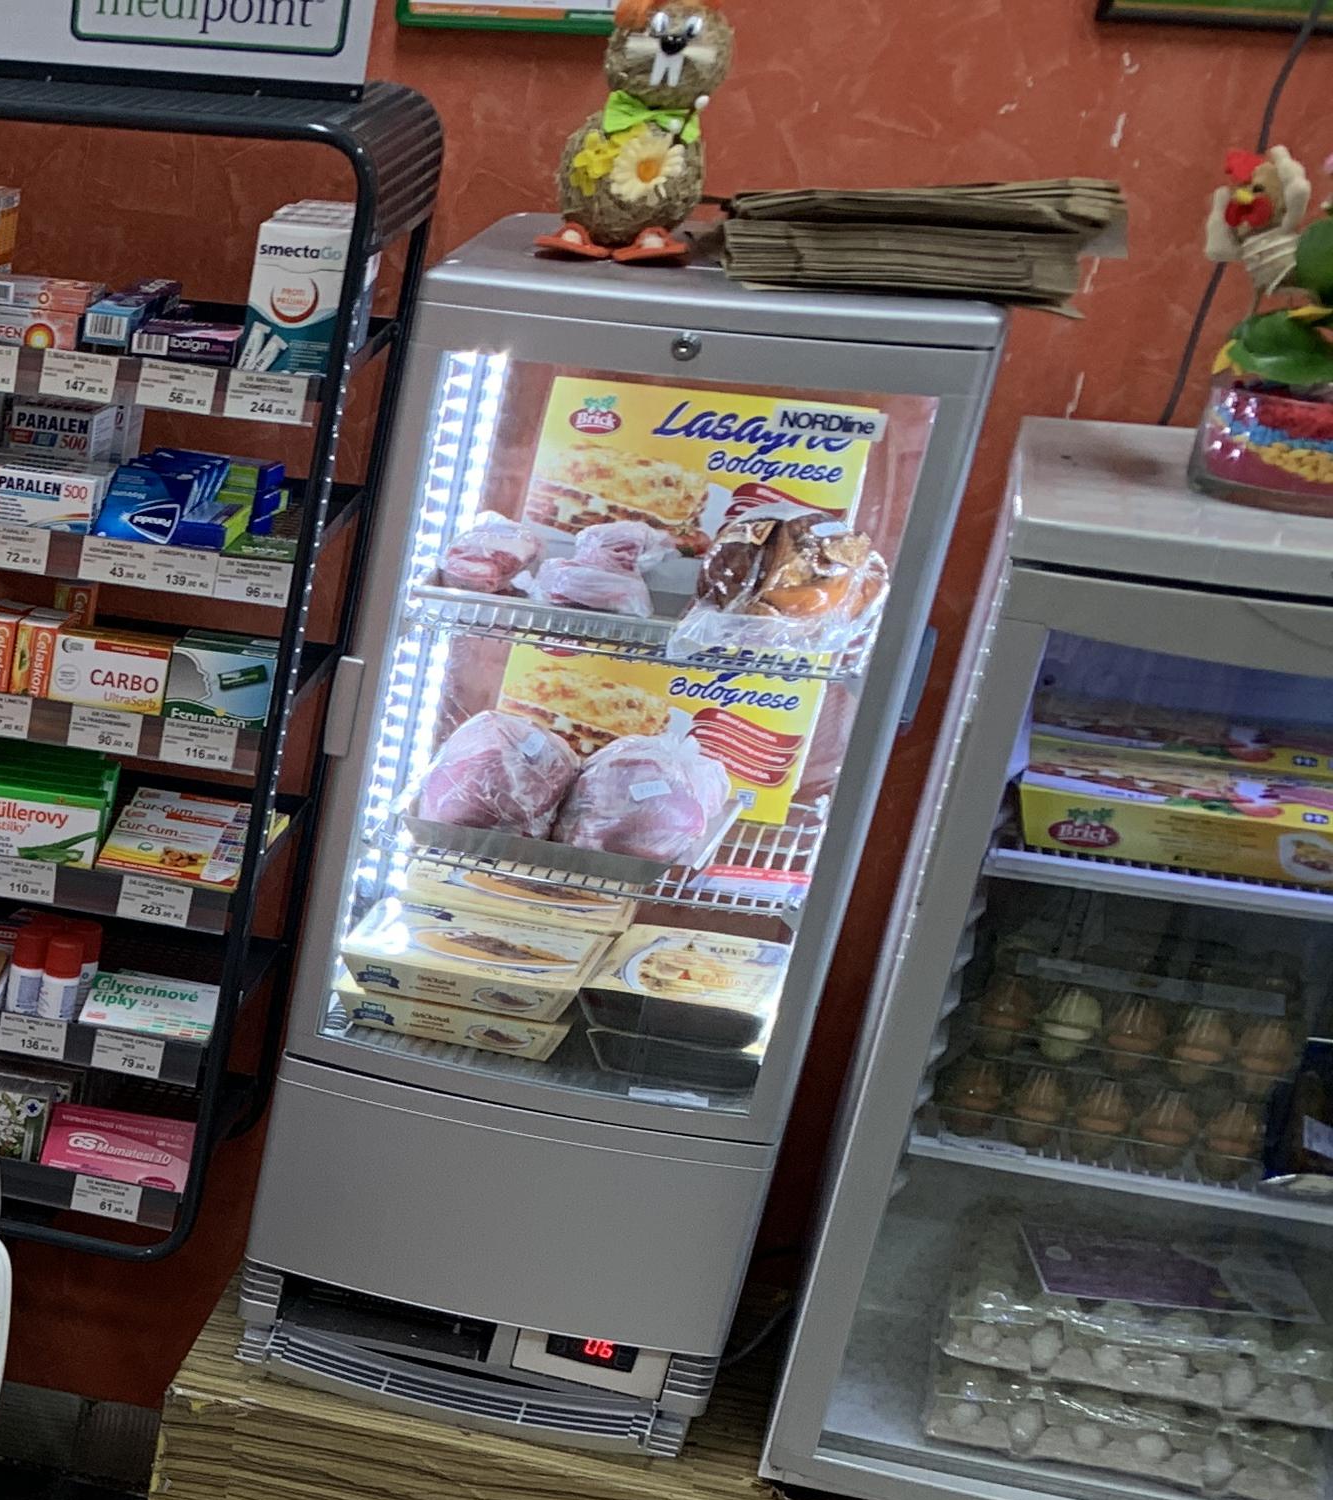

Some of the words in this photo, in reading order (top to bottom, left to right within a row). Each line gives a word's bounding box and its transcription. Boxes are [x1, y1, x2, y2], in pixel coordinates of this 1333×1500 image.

[259, 242, 344, 262] smectaGo
[16, 412, 89, 435] PARALEN
[574, 408, 618, 429] Brick
[780, 411, 876, 436] NORDline
[59, 435, 88, 451] 500
[707, 450, 844, 484] Bolognese
[64, 484, 88, 500] 500
[133, 514, 173, 528] Panadol
[30, 629, 53, 698] Celaskon
[89, 668, 160, 694] CARBO
[103, 692, 157, 709] UltraSorb
[669, 677, 800, 713] Bolognese
[133, 800, 193, 817] Cur-Cum
[118, 819, 179, 838] Cur-Cum
[1055, 822, 1113, 847] Brick
[709, 945, 757, 958] WARNING
[96, 975, 199, 1003] Glycerinové
[93, 990, 138, 1010] čípky
[96, 1141, 155, 1164] Mamatest
